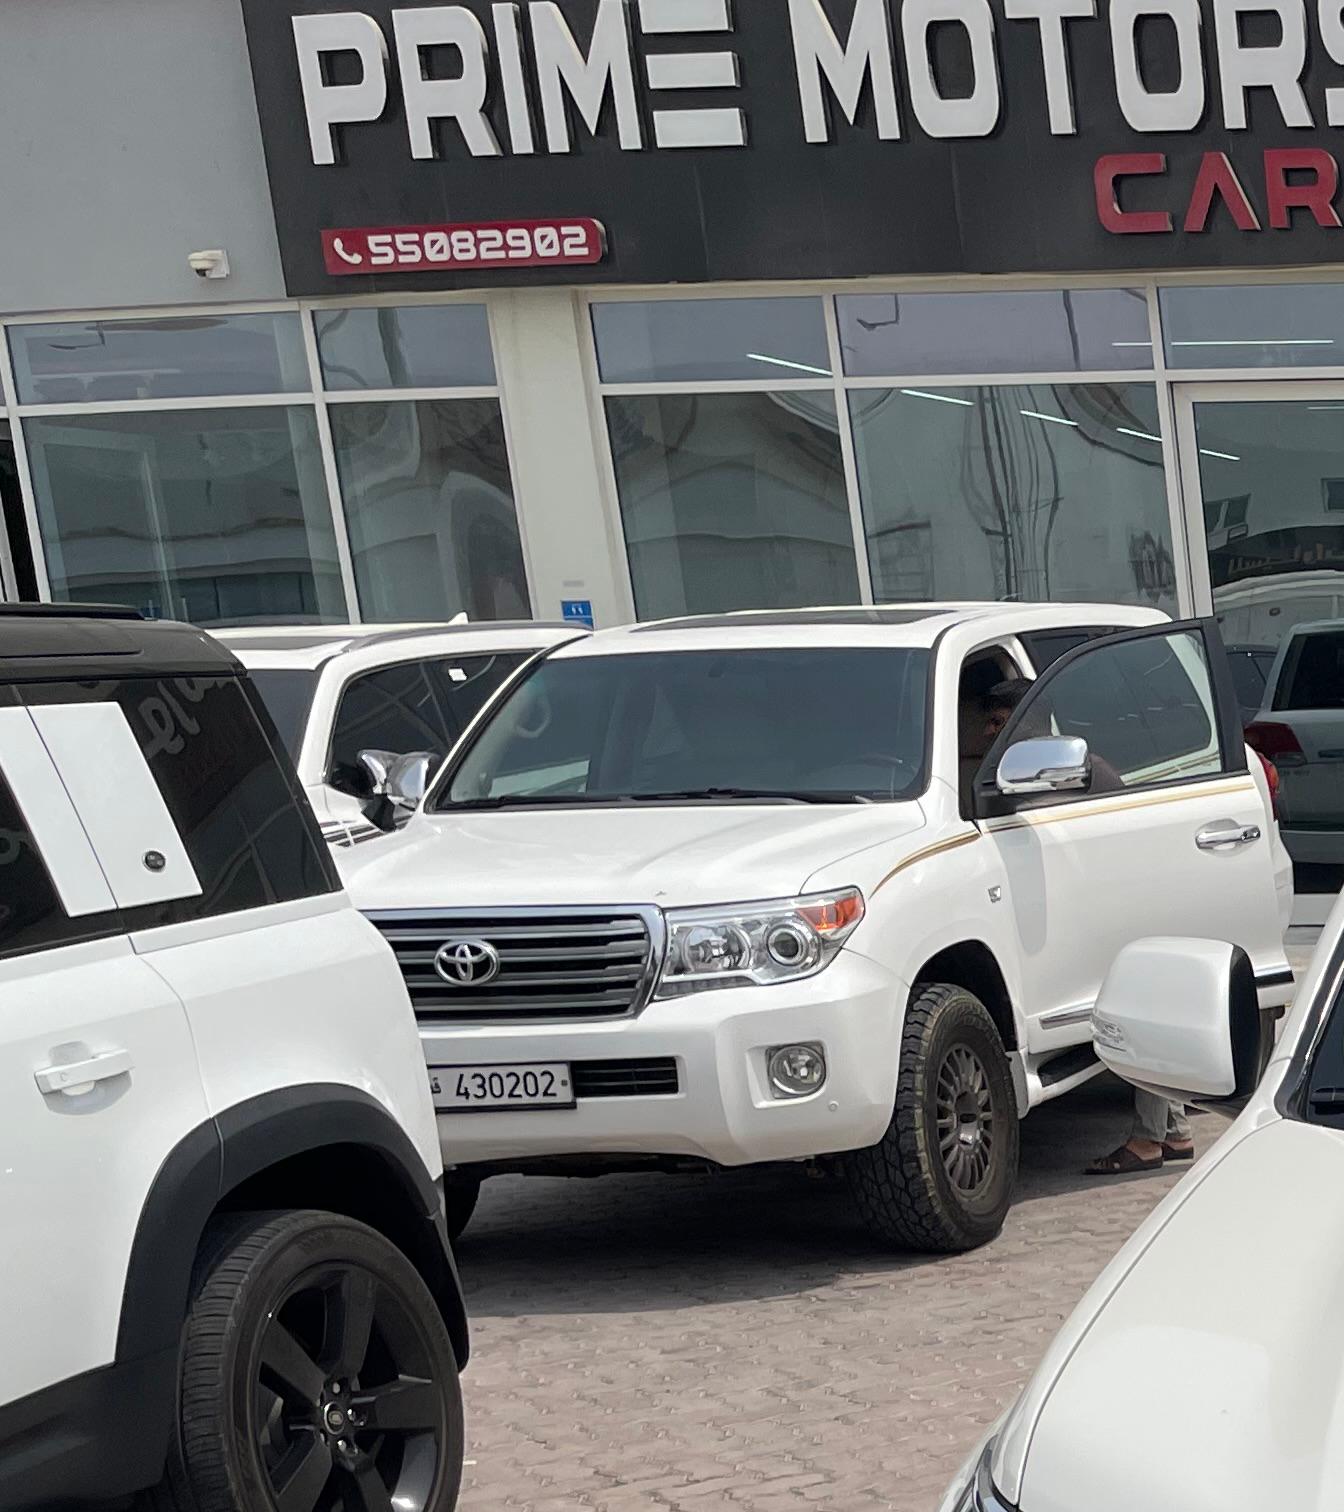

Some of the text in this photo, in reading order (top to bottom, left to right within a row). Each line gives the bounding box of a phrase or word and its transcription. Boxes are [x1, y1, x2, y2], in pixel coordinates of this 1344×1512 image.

[291, 0, 748, 166] PRIME
[366, 226, 590, 266] 55082902
[455, 1069, 558, 1101] 430202
